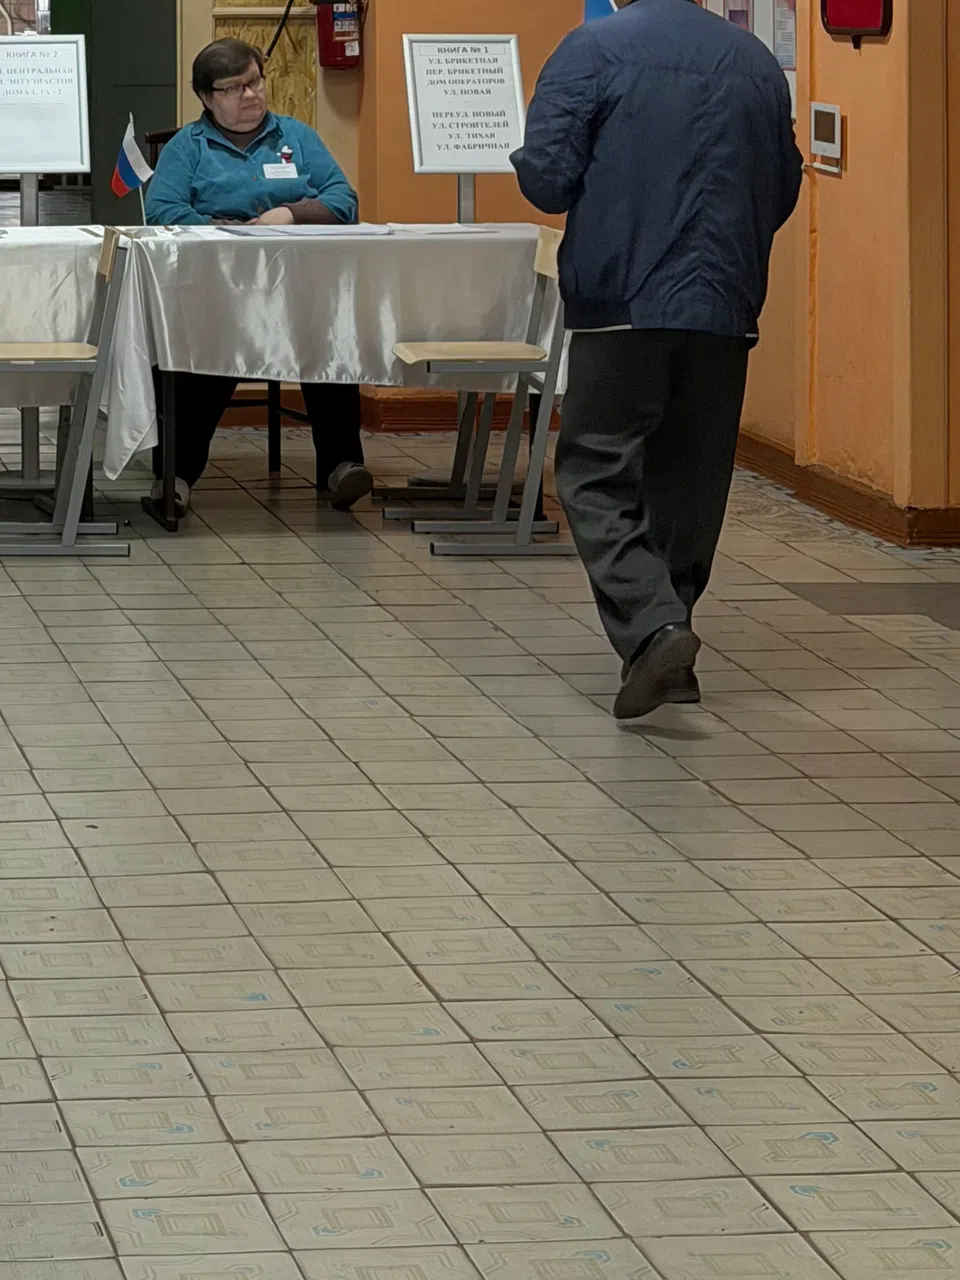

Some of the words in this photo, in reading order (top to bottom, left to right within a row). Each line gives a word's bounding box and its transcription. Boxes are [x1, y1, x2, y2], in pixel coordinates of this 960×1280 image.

[437, 46, 468, 54] КНИГА
[6, 51, 37, 59] КНИГА
[6, 67, 73, 75] ЦЕНТРАЛЬНАЯ
[447, 66, 504, 75] БРИКЕТНЫЙ
[472, 109, 506, 118] НОВЫЙ
[448, 120, 509, 129] СТРОИТЕЛЕЙ
[436, 143, 452, 151] УЛ.
[453, 142, 510, 150] ФАБРИЧНАЯ
